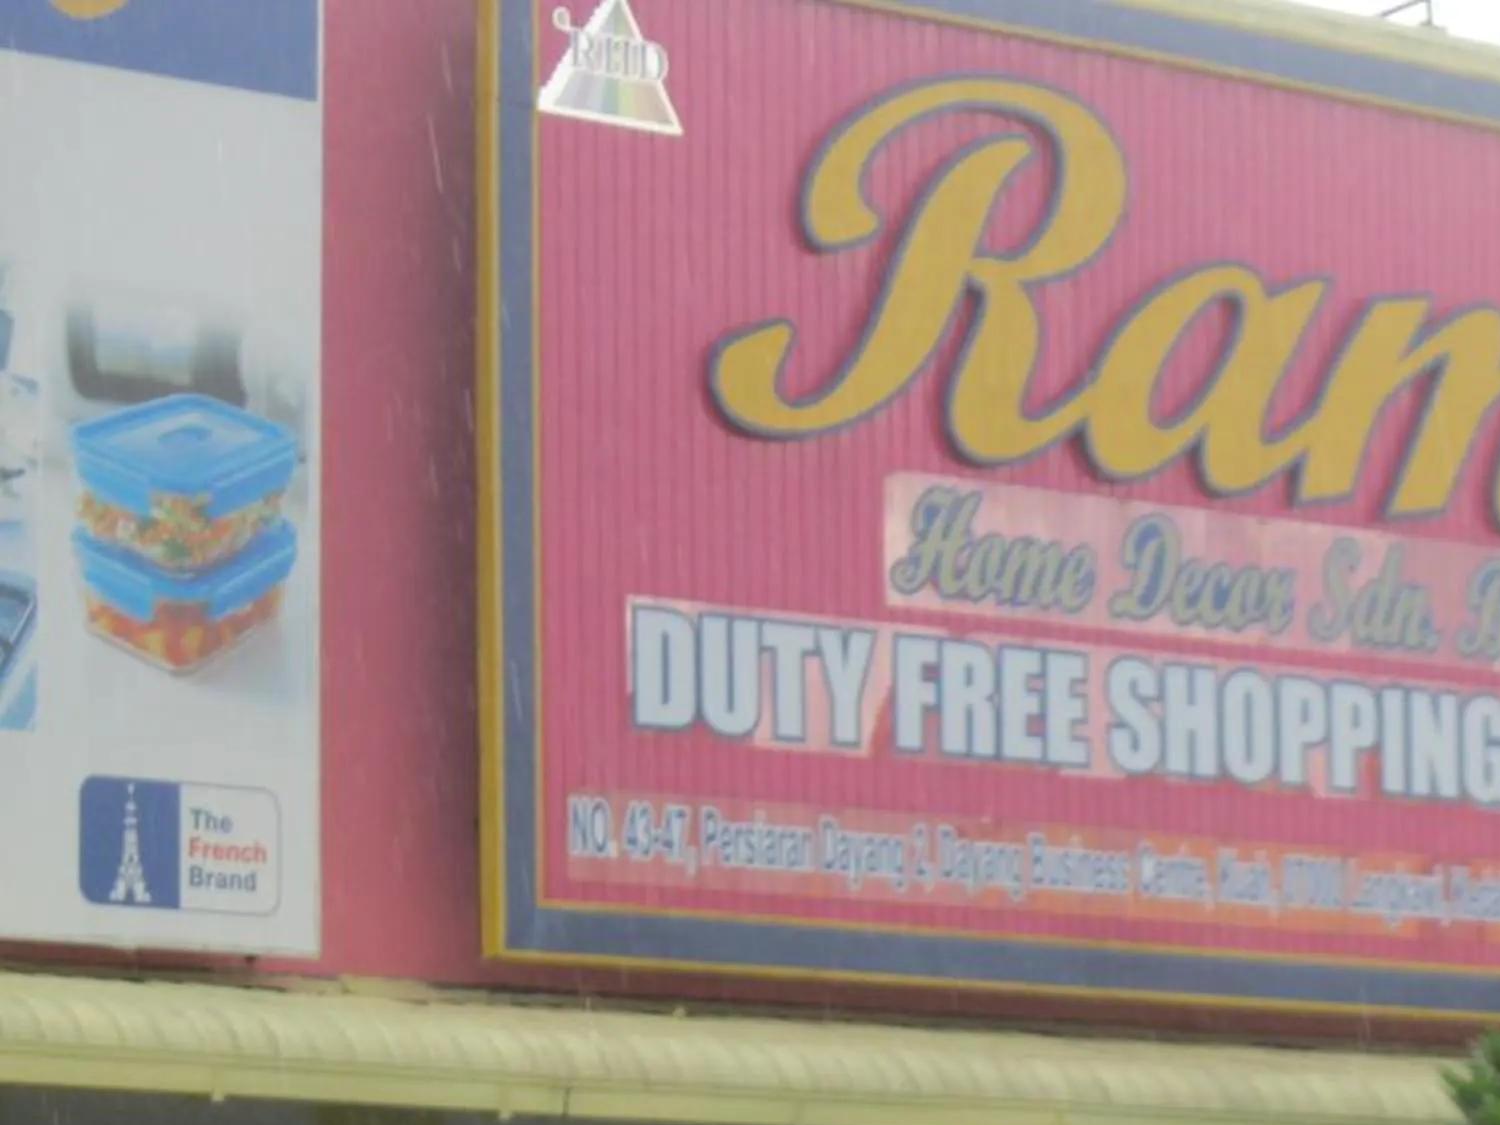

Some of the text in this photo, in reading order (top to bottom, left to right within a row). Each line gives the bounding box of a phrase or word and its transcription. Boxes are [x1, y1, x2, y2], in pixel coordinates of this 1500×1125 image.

[889, 483, 1096, 614] Home
[1108, 511, 1296, 634] Decor
[1308, 536, 1440, 654] Sdn.
[631, 604, 876, 750] DUTY
[891, 631, 1091, 770] FREE
[188, 806, 234, 835] The
[188, 836, 268, 864] French
[567, 797, 618, 858] NO.
[701, 805, 815, 870] Persiaran
[818, 815, 906, 892] Dayang
[188, 865, 258, 892] Brand
